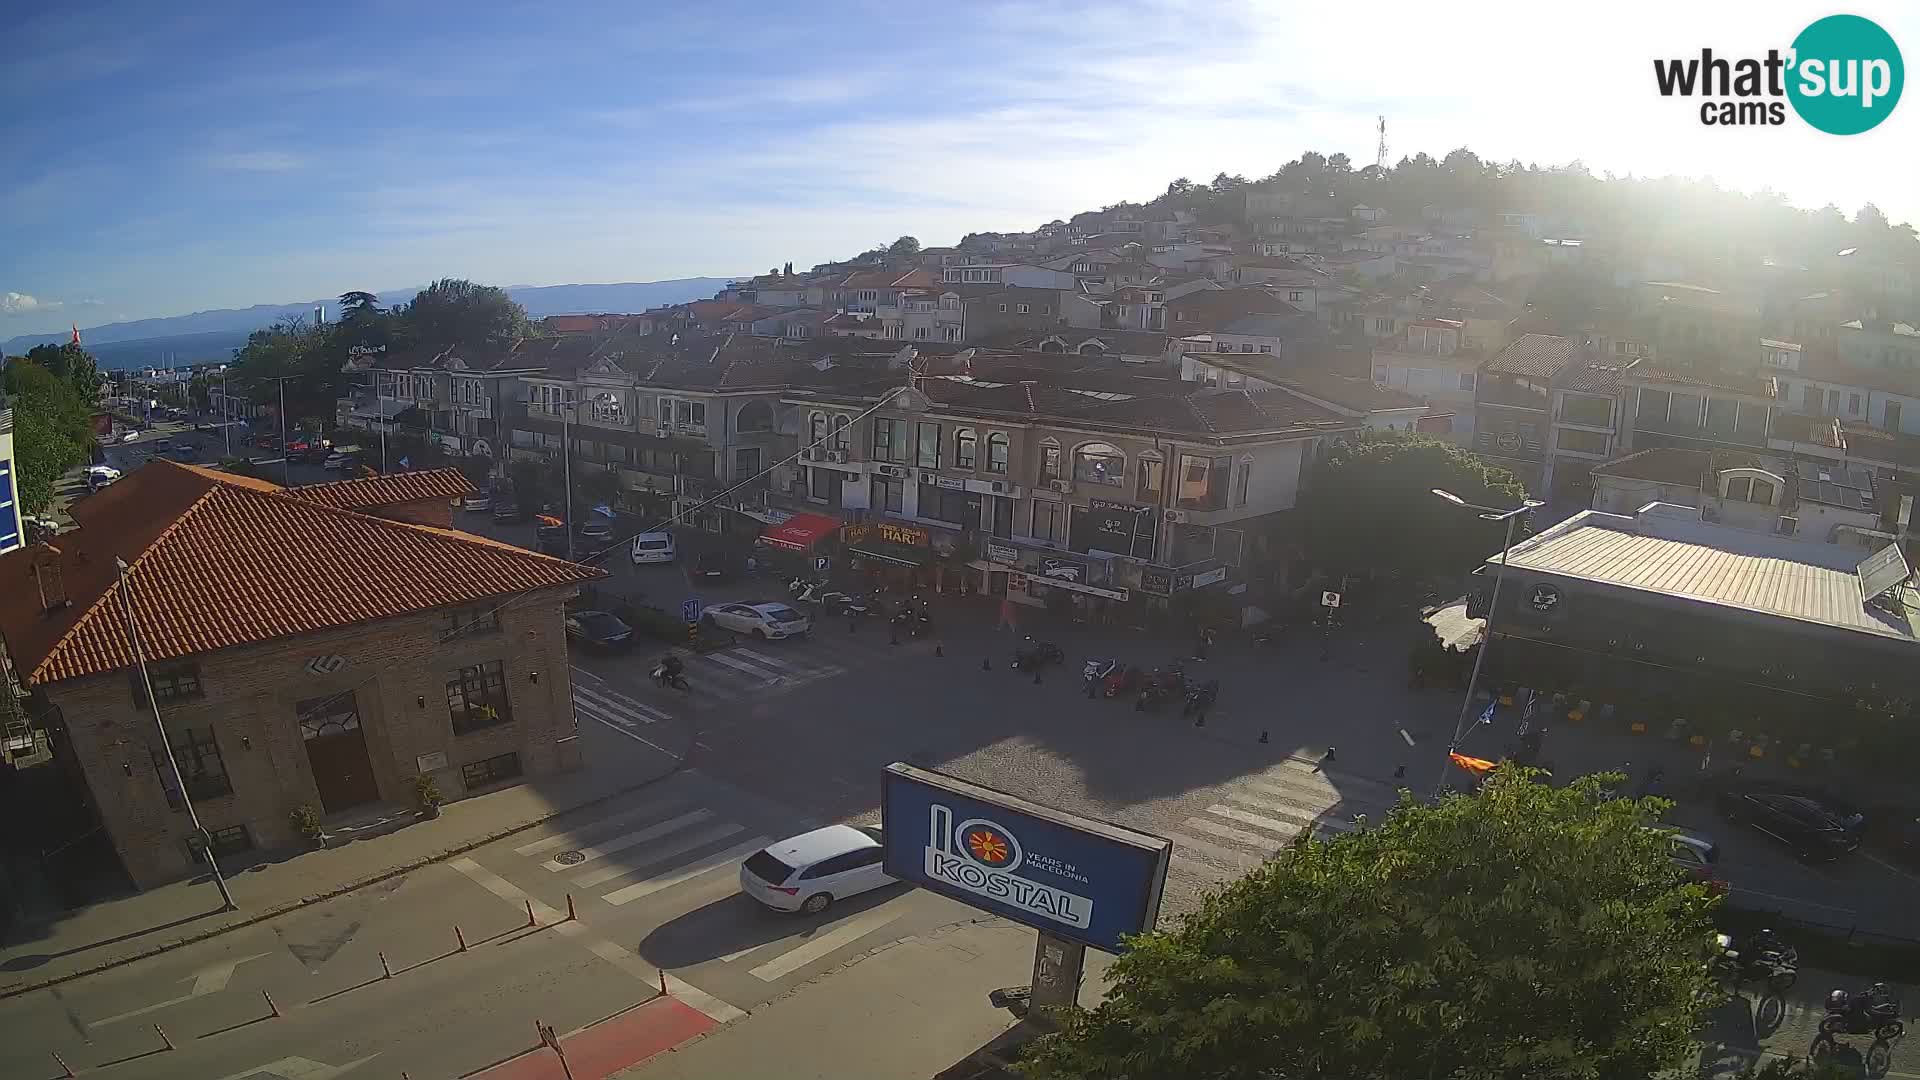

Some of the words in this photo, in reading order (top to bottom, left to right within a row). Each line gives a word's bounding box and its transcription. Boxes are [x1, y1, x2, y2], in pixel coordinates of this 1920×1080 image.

[818, 558, 826, 569] P
[1026, 858, 1089, 884] MACEDONIA
[1027, 851, 1062, 869] YEARS
[1064, 863, 1076, 872] IN
[934, 853, 1080, 922] KOSTAL
